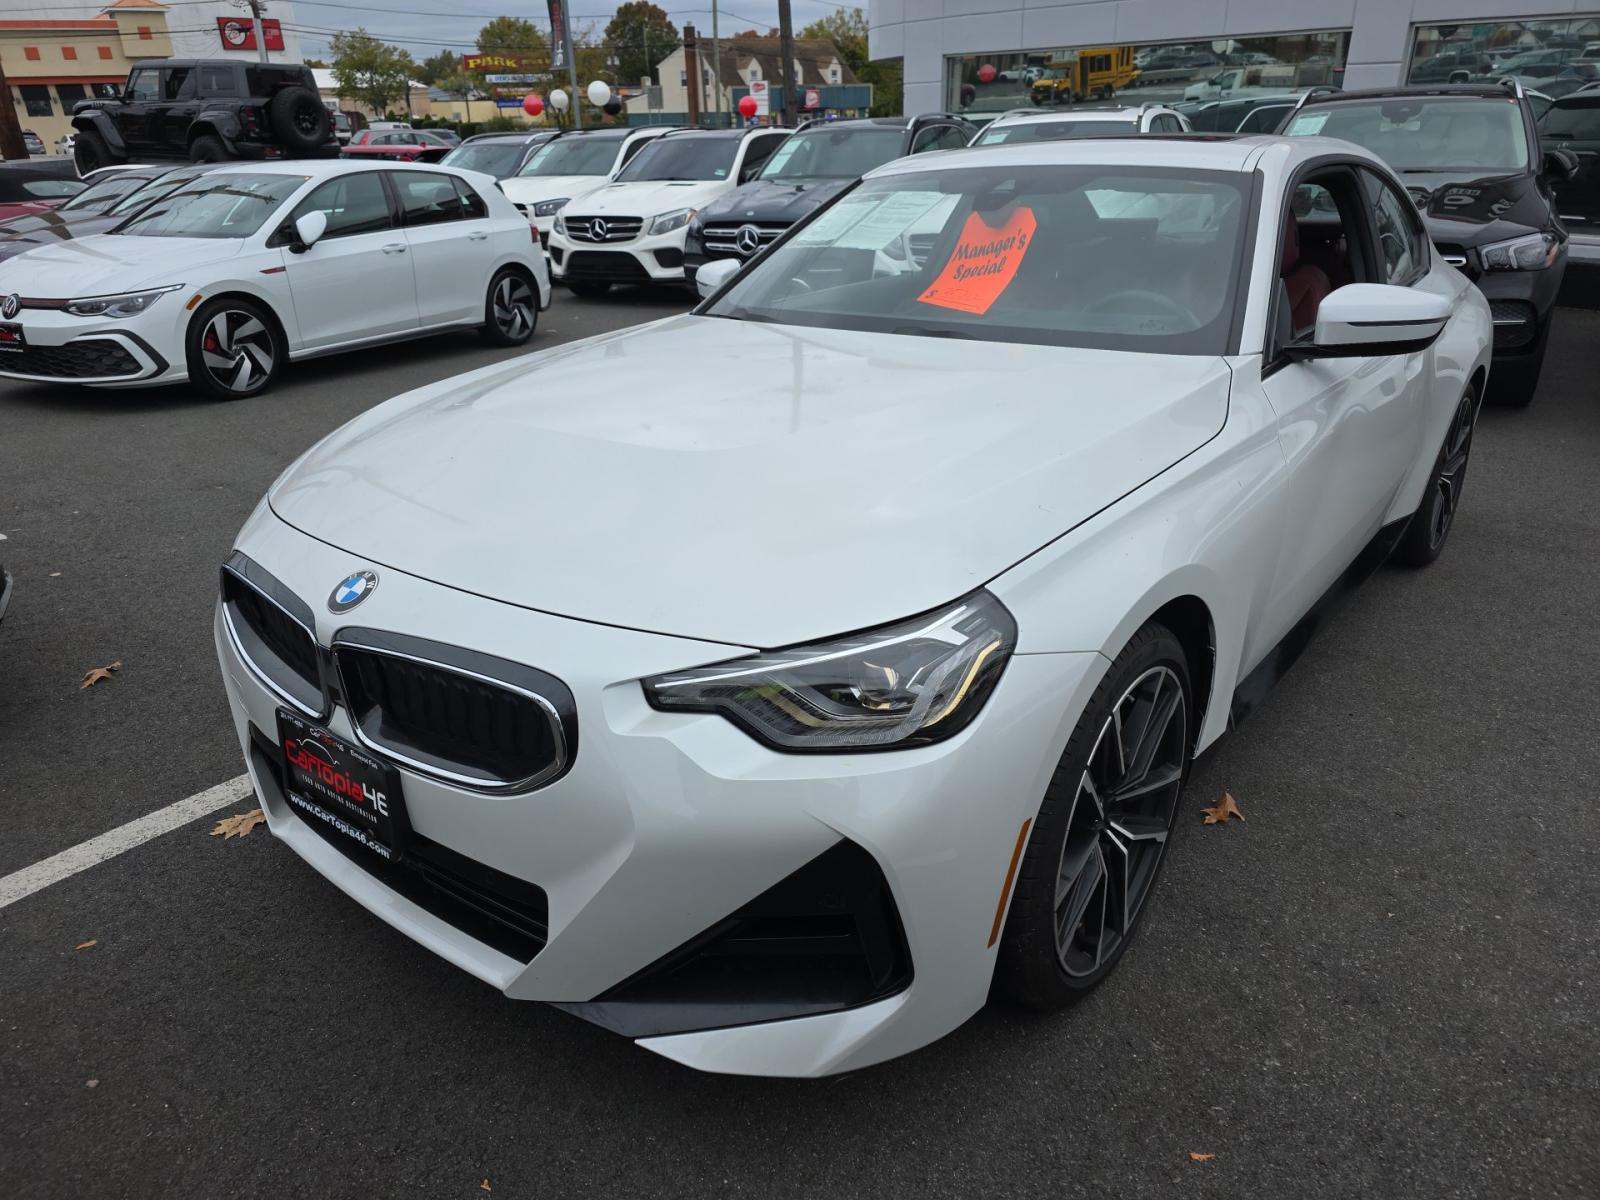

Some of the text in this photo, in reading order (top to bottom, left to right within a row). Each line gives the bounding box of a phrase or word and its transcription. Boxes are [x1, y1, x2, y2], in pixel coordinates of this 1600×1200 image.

[952, 227, 1027, 261] Manager's
[953, 255, 1008, 282] Special
[290, 794, 390, 860] www.CarTopia46.com
